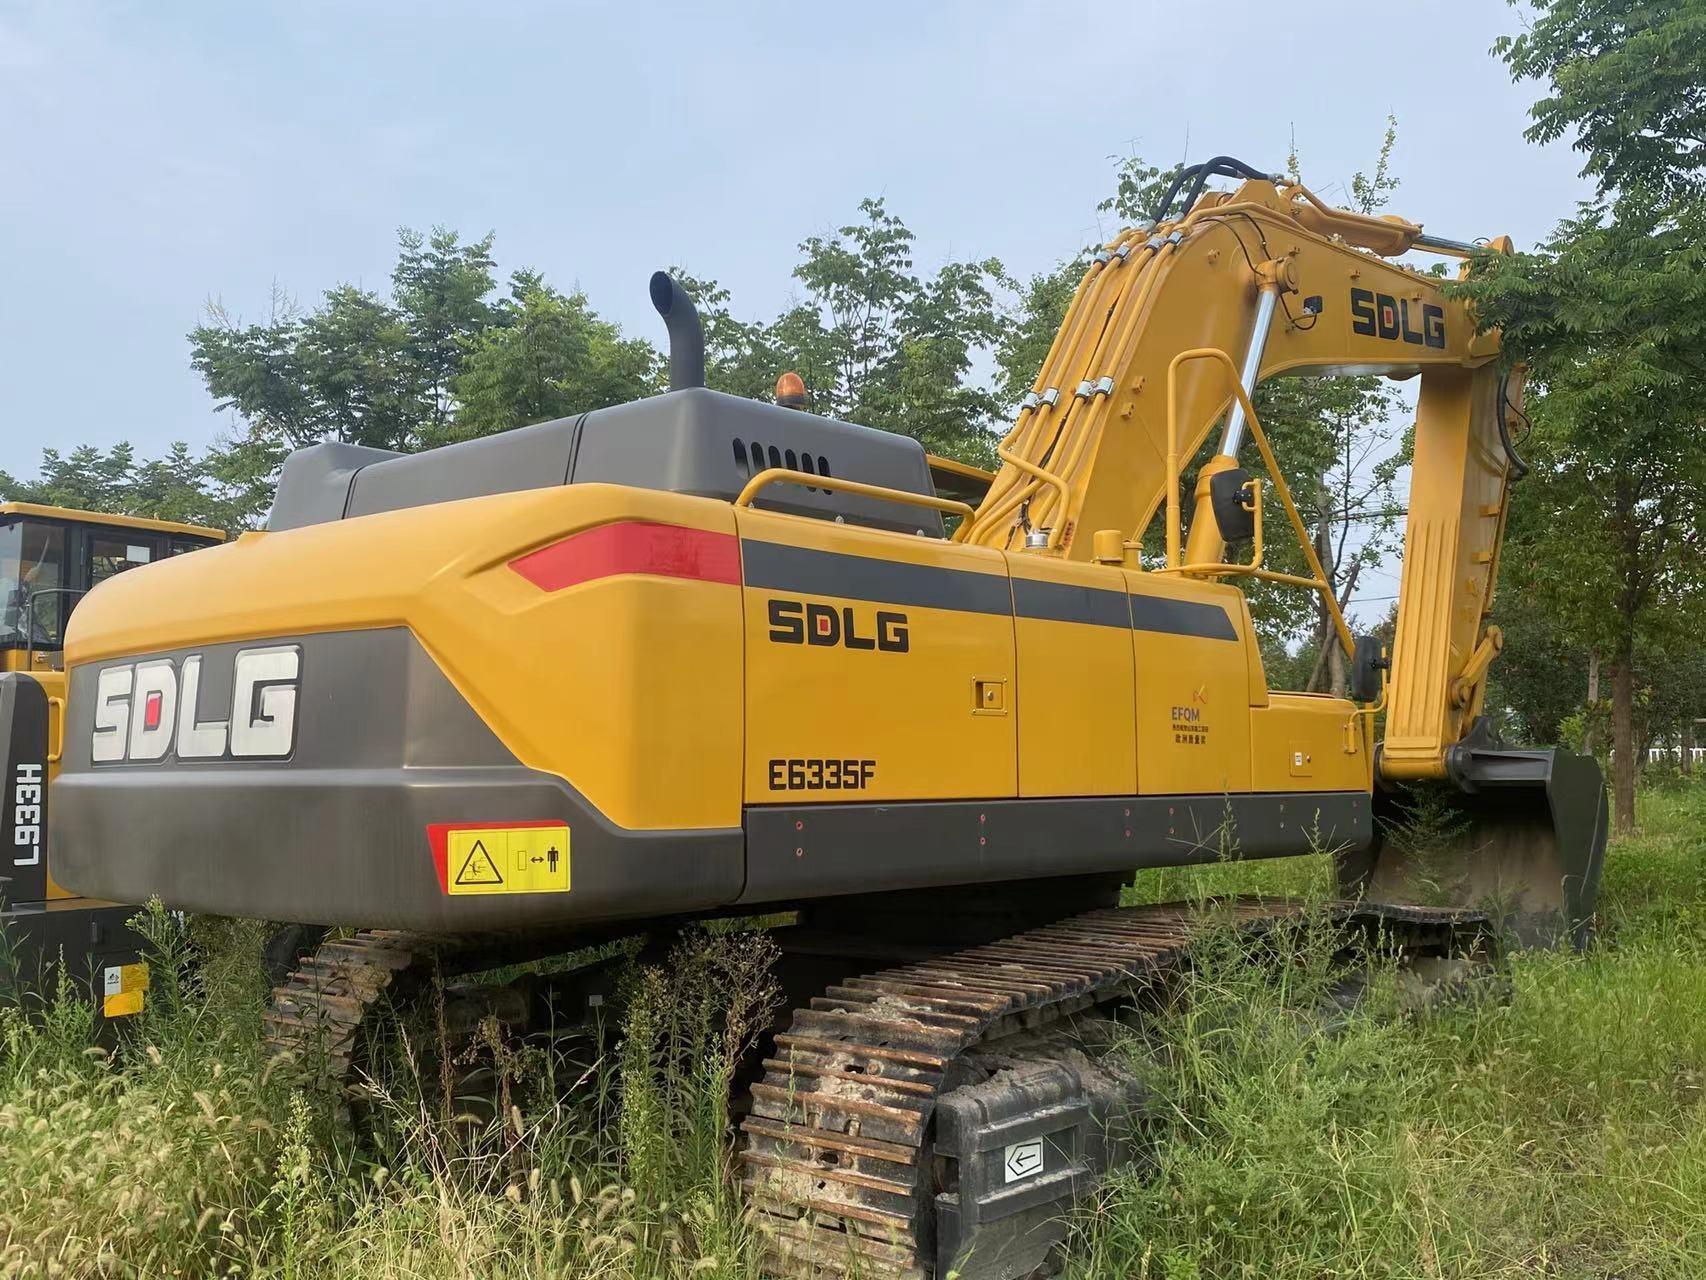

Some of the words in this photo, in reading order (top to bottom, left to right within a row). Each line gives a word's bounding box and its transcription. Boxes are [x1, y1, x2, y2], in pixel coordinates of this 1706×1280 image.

[1351, 287, 1446, 349] SDLG
[768, 599, 909, 653] SDLG
[92, 644, 300, 762] SDLG
[1171, 706, 1201, 722] EFQM
[768, 759, 876, 790] E6335F
[14, 763, 42, 866] L933H
